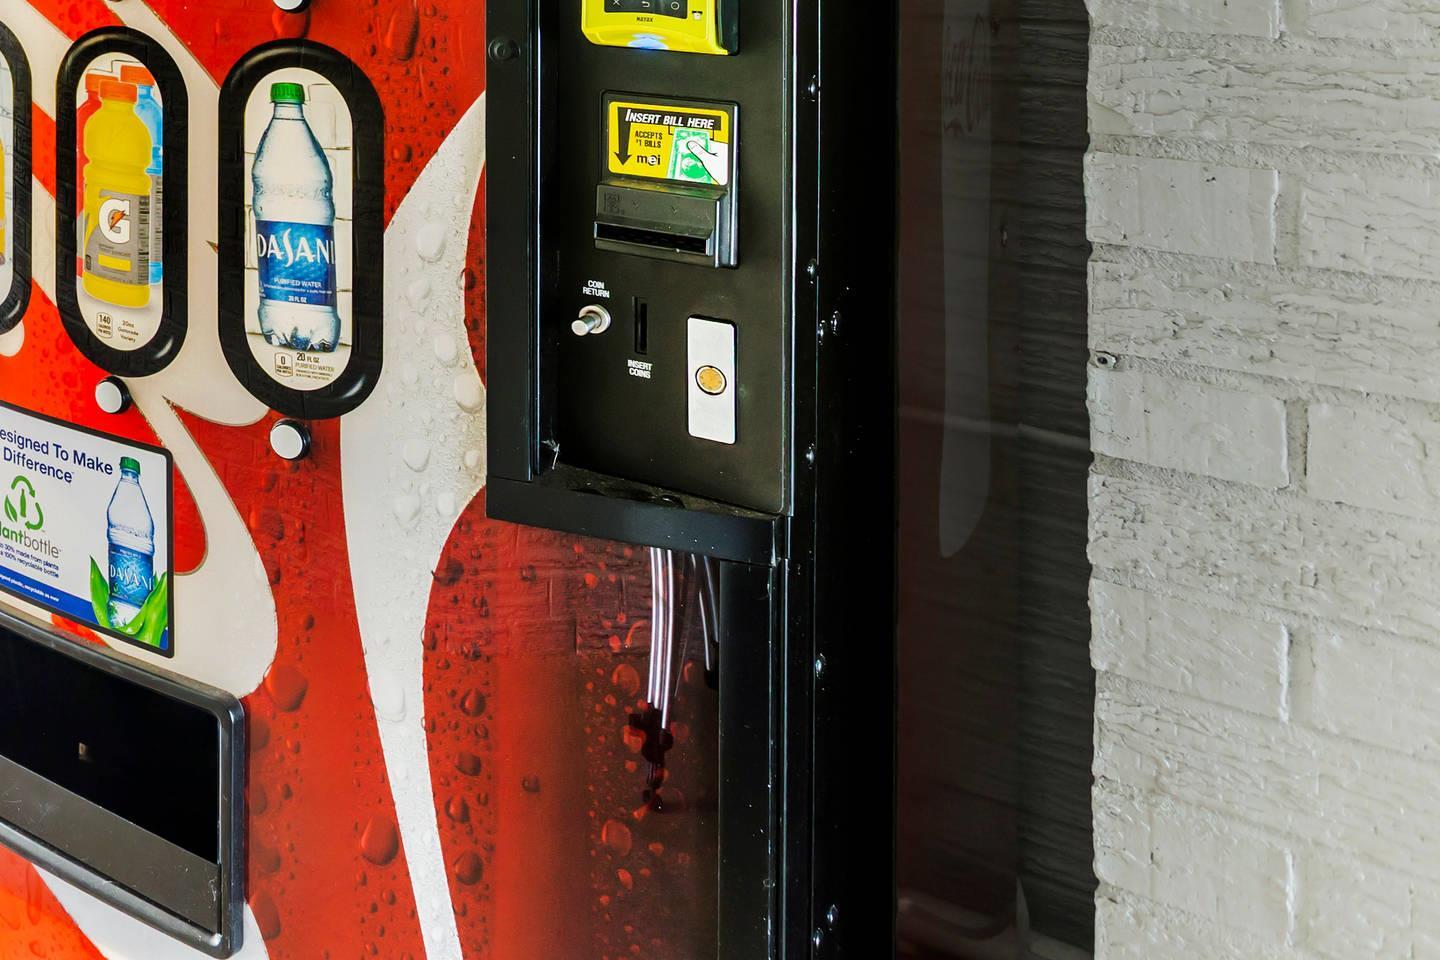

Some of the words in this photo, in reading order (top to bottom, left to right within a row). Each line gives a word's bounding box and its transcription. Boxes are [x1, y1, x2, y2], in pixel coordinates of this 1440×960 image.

[625, 109, 661, 123] INSERT
[663, 115, 684, 126] BILL
[687, 118, 714, 129] HERE
[635, 131, 662, 140] ACCEPTS
[645, 140, 661, 148] BILLS
[637, 155, 660, 166] mei
[99, 198, 130, 244] G
[257, 228, 334, 268] DASANI
[274, 277, 300, 286] PURIFIED
[588, 280, 605, 289] COIN
[583, 287, 609, 298] RETURN
[99, 315, 110, 324] 140
[297, 352, 305, 361] 20
[628, 360, 652, 371] INSERT
[629, 368, 651, 379] COINS
[4, 447, 72, 483] Difference
[53, 444, 69, 460] To
[73, 452, 113, 476] Make
[16, 550, 29, 559] made
[31, 554, 42, 564] from
[43, 561, 59, 570] plants
[44, 569, 59, 578] bottle
